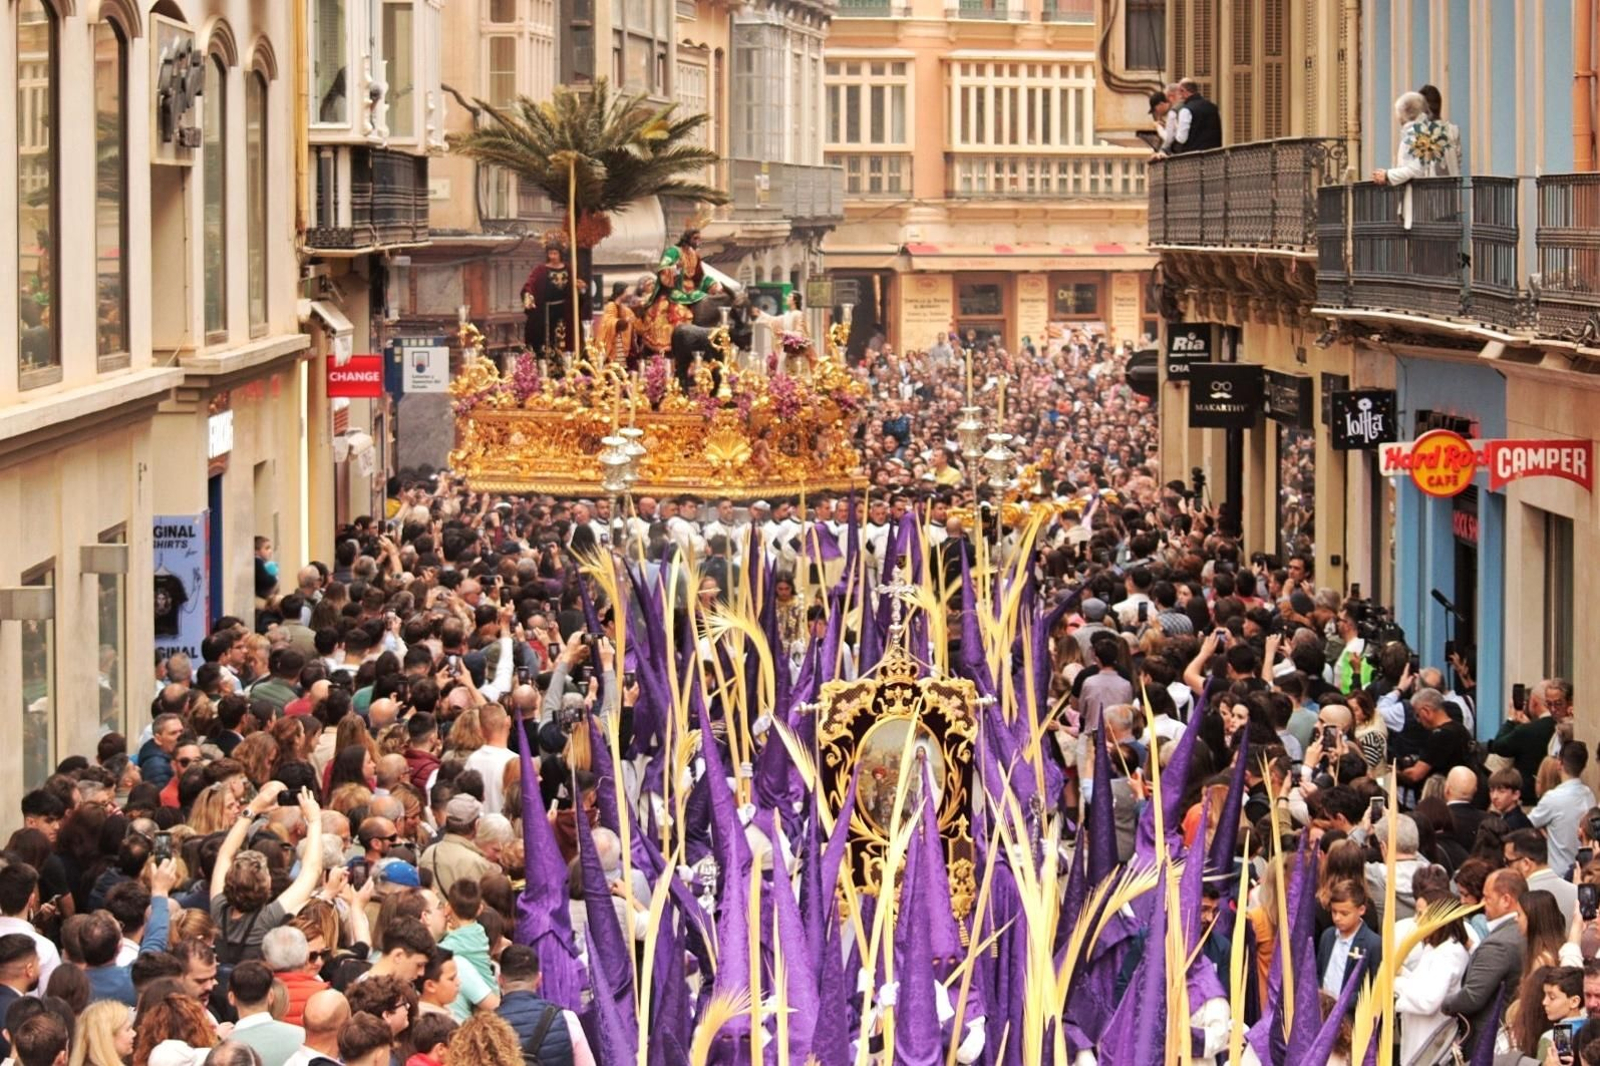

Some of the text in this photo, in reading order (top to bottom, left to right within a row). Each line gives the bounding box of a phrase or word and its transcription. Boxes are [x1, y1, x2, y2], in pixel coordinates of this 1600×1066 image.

[1172, 332, 1205, 351] Ria
[329, 371, 380, 382] CHANGE
[1195, 403, 1245, 412] MAKARTHY
[1385, 445, 1440, 471] Hard
[1497, 447, 1587, 479] CAMPER
[1427, 474, 1459, 487] CAFE
